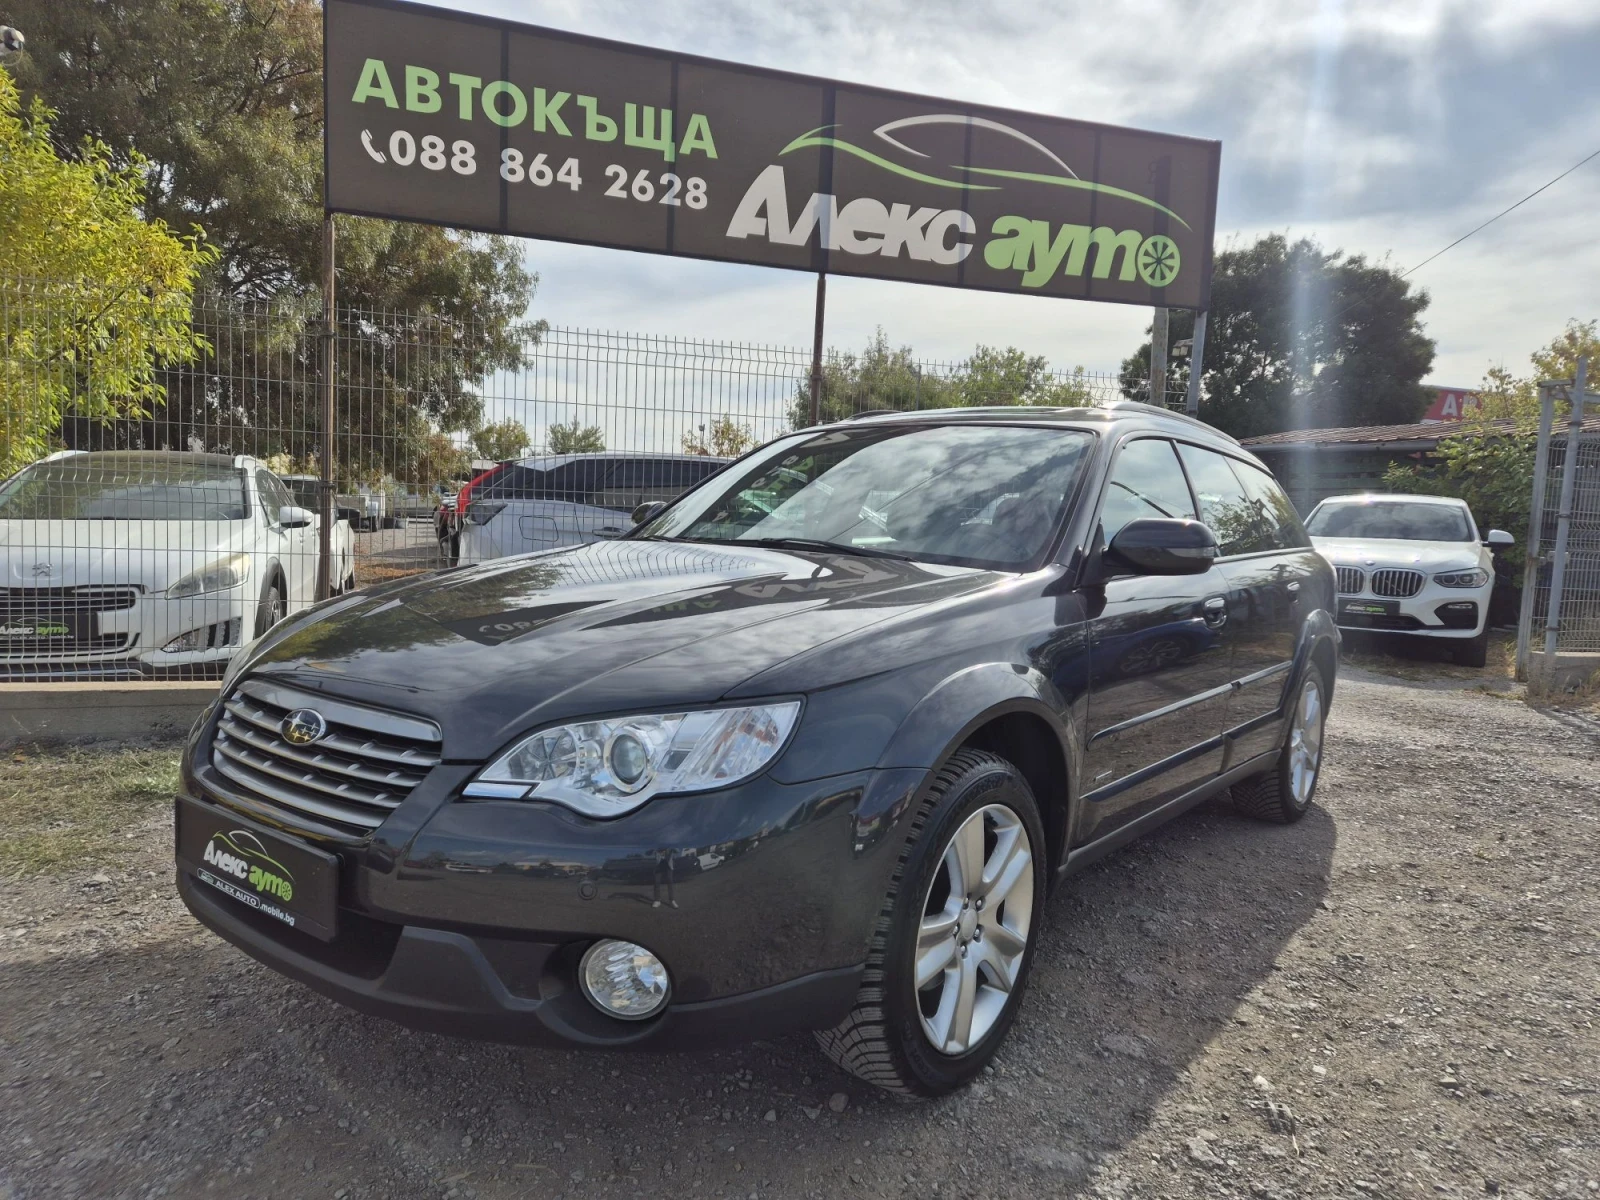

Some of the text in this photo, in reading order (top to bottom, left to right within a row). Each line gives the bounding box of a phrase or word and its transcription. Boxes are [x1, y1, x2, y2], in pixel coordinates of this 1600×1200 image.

[352, 58, 718, 162] АВТОКЪЩА
[389, 130, 708, 210] 088 864 2628
[726, 164, 976, 265] Алекс
[204, 840, 248, 879] Алекс
[215, 880, 235, 896] ALEX
[235, 890, 257, 906] AUTO
